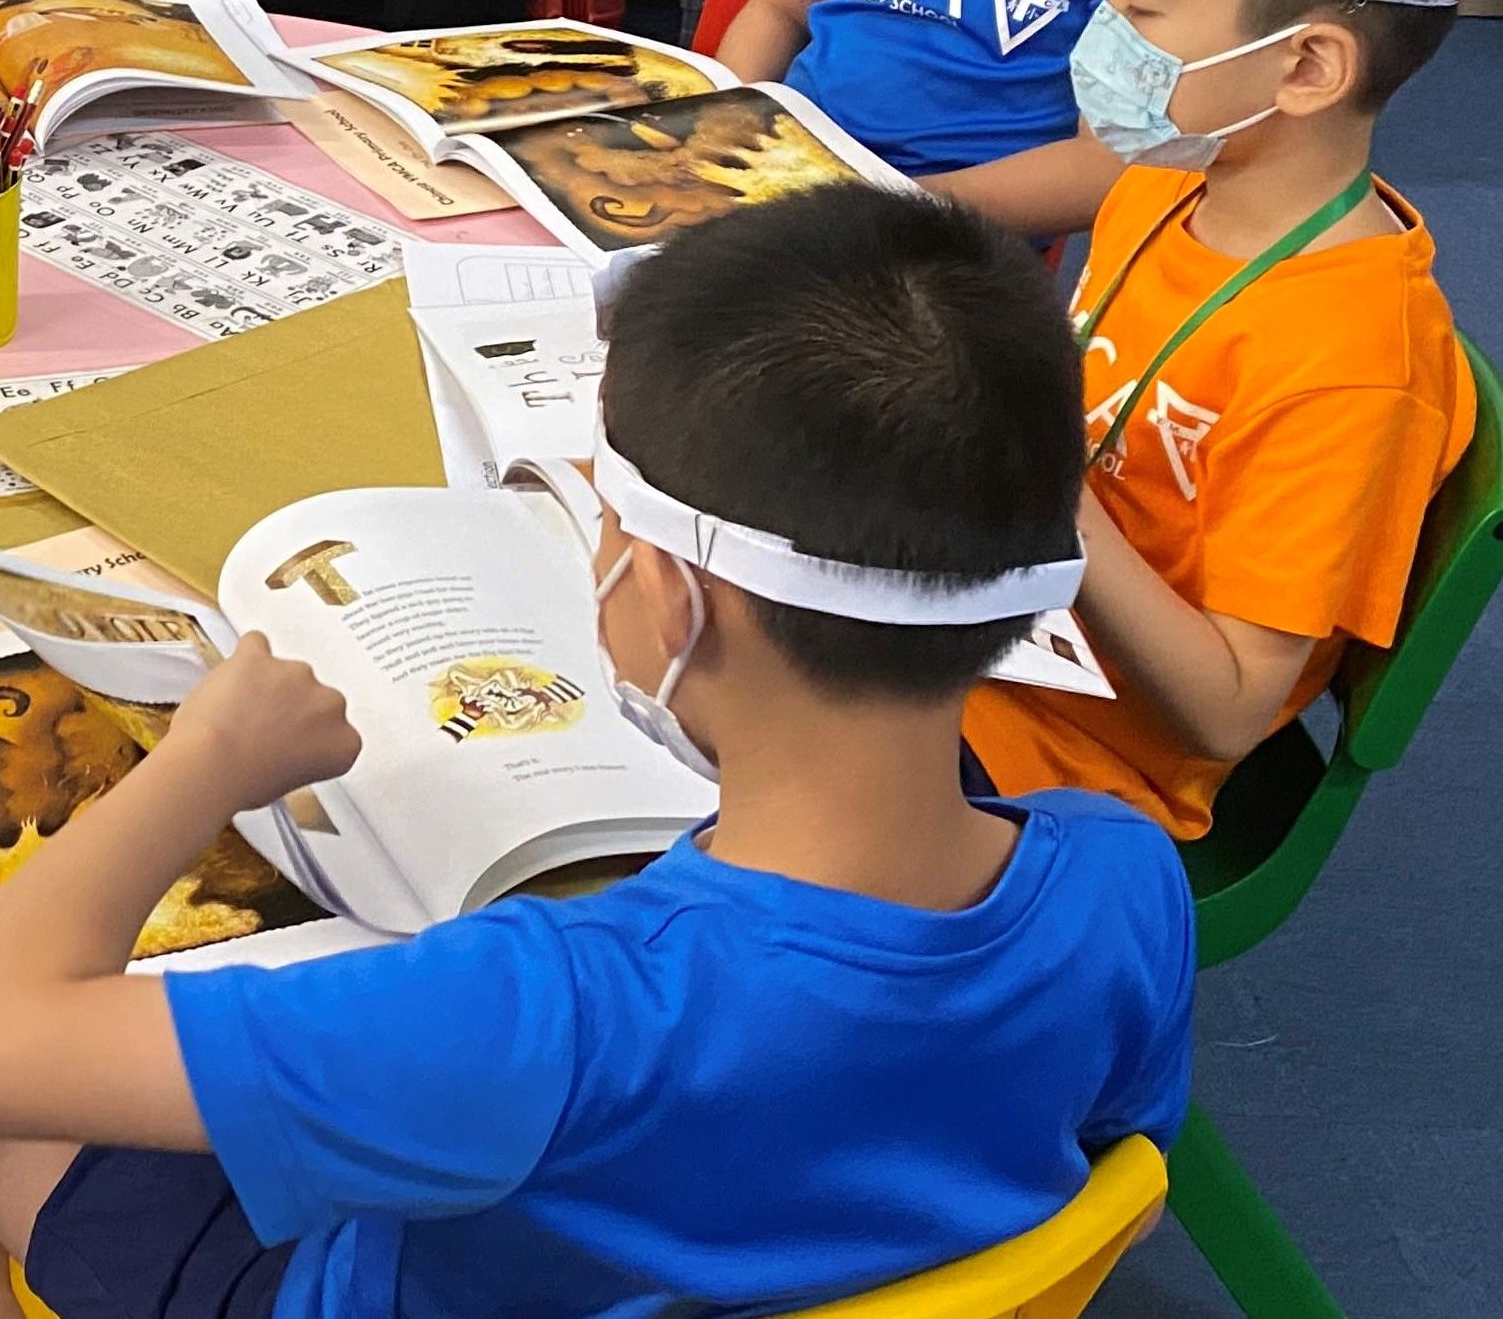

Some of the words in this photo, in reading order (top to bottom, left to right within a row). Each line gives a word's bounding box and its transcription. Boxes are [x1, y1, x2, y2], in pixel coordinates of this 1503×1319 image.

[387, 162, 419, 183] YMCA
[248, 211, 275, 227] Uu
[162, 234, 198, 254] Mm
[100, 271, 134, 289] Dd
[173, 304, 201, 320] Bb
[0, 386, 32, 399] Ee
